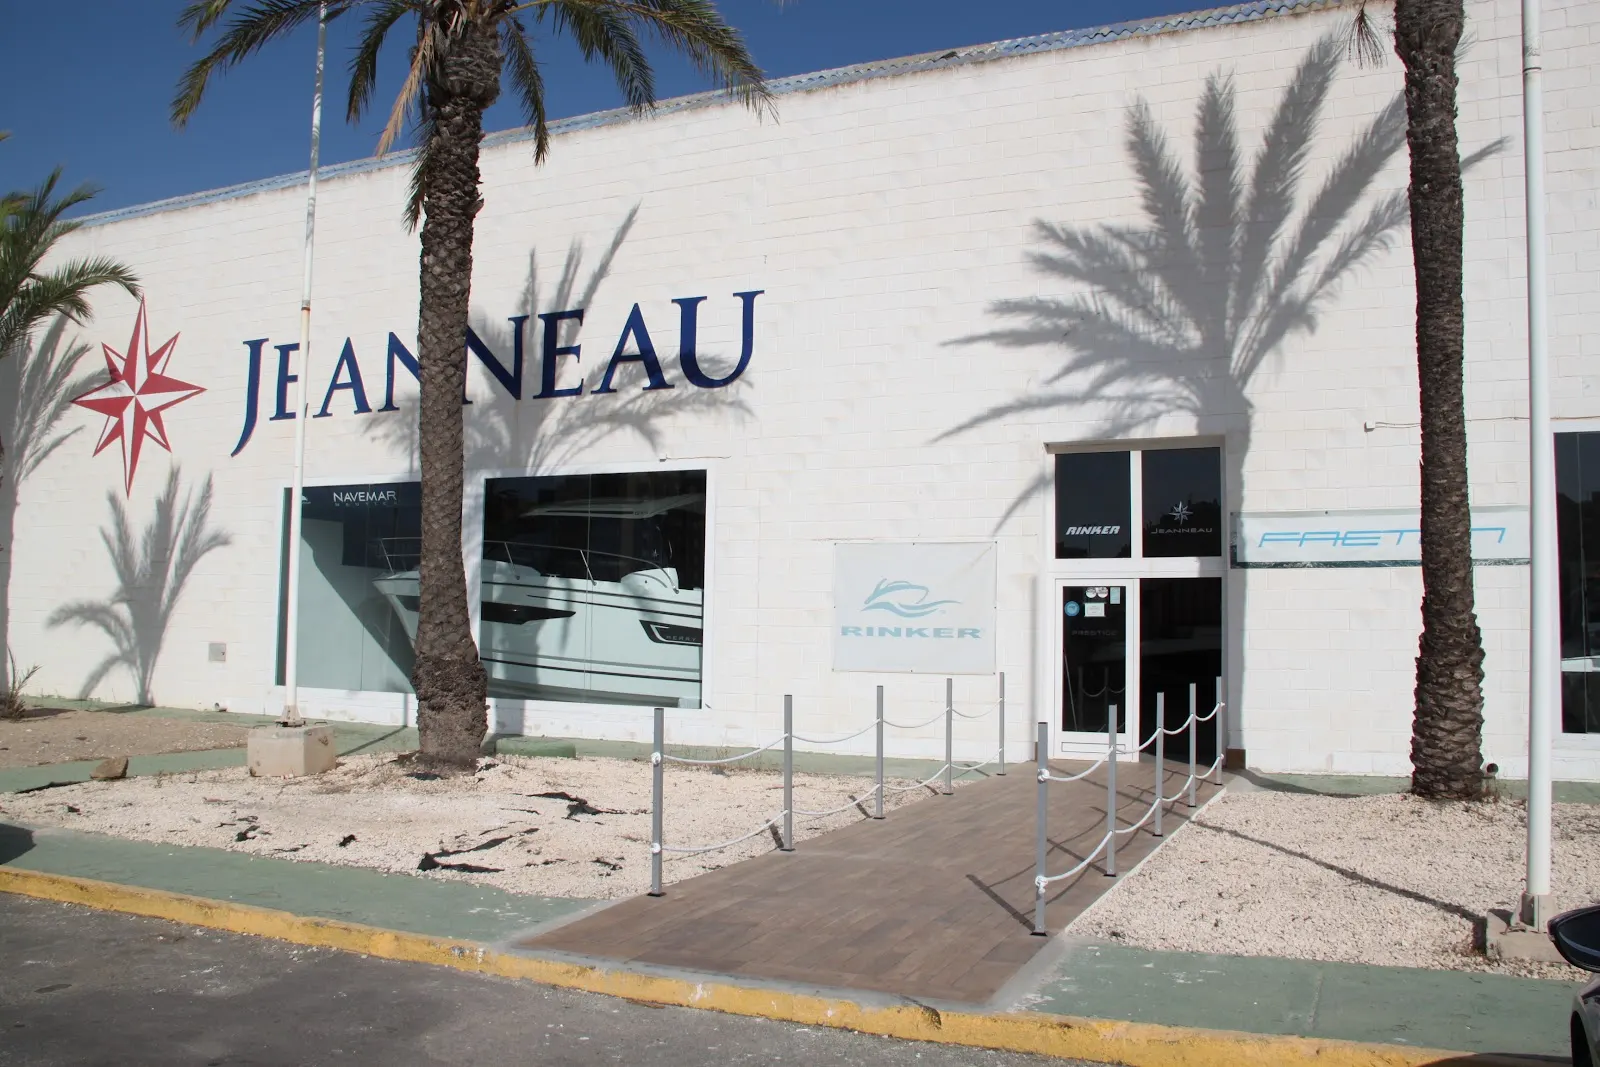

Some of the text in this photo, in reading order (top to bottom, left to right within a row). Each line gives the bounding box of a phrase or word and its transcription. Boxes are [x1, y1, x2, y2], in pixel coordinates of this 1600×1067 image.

[231, 290, 765, 458] JEANNEAU
[333, 490, 397, 502] NAVEMAR
[1065, 525, 1121, 536] RINKER
[1150, 527, 1213, 535] JEANNEAU
[1258, 527, 1506, 548] FAETN
[841, 625, 982, 639] RINKER
